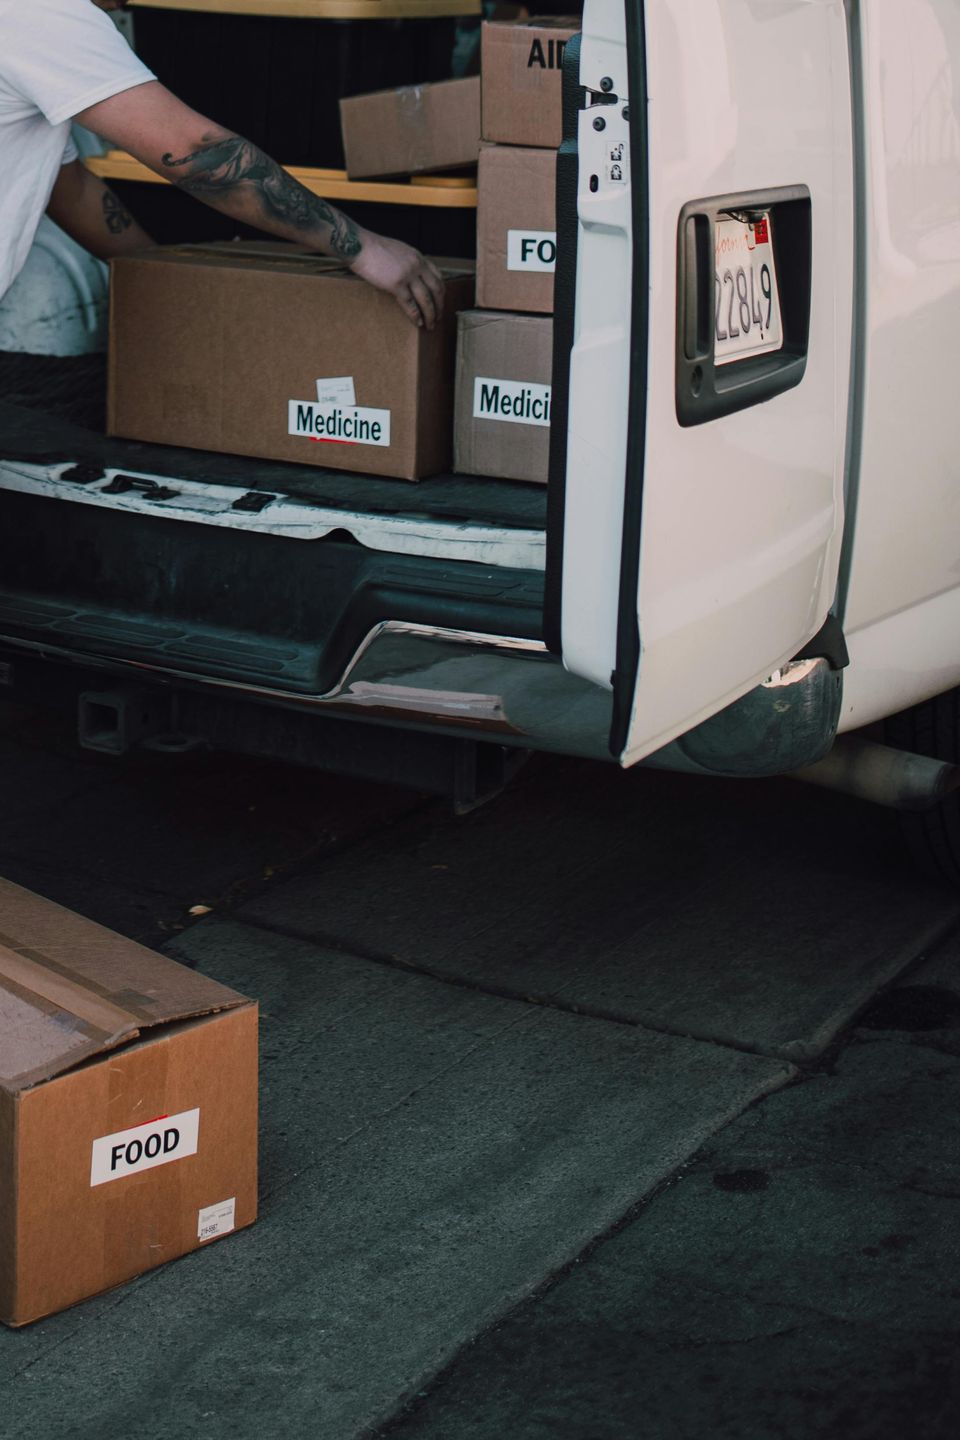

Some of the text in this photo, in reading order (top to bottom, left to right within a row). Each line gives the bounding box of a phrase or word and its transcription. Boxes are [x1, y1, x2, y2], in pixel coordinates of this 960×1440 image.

[521, 239, 556, 263] FO
[480, 384, 549, 421] Medici
[297, 405, 382, 441] Medicine
[111, 1127, 180, 1172] FOOD
